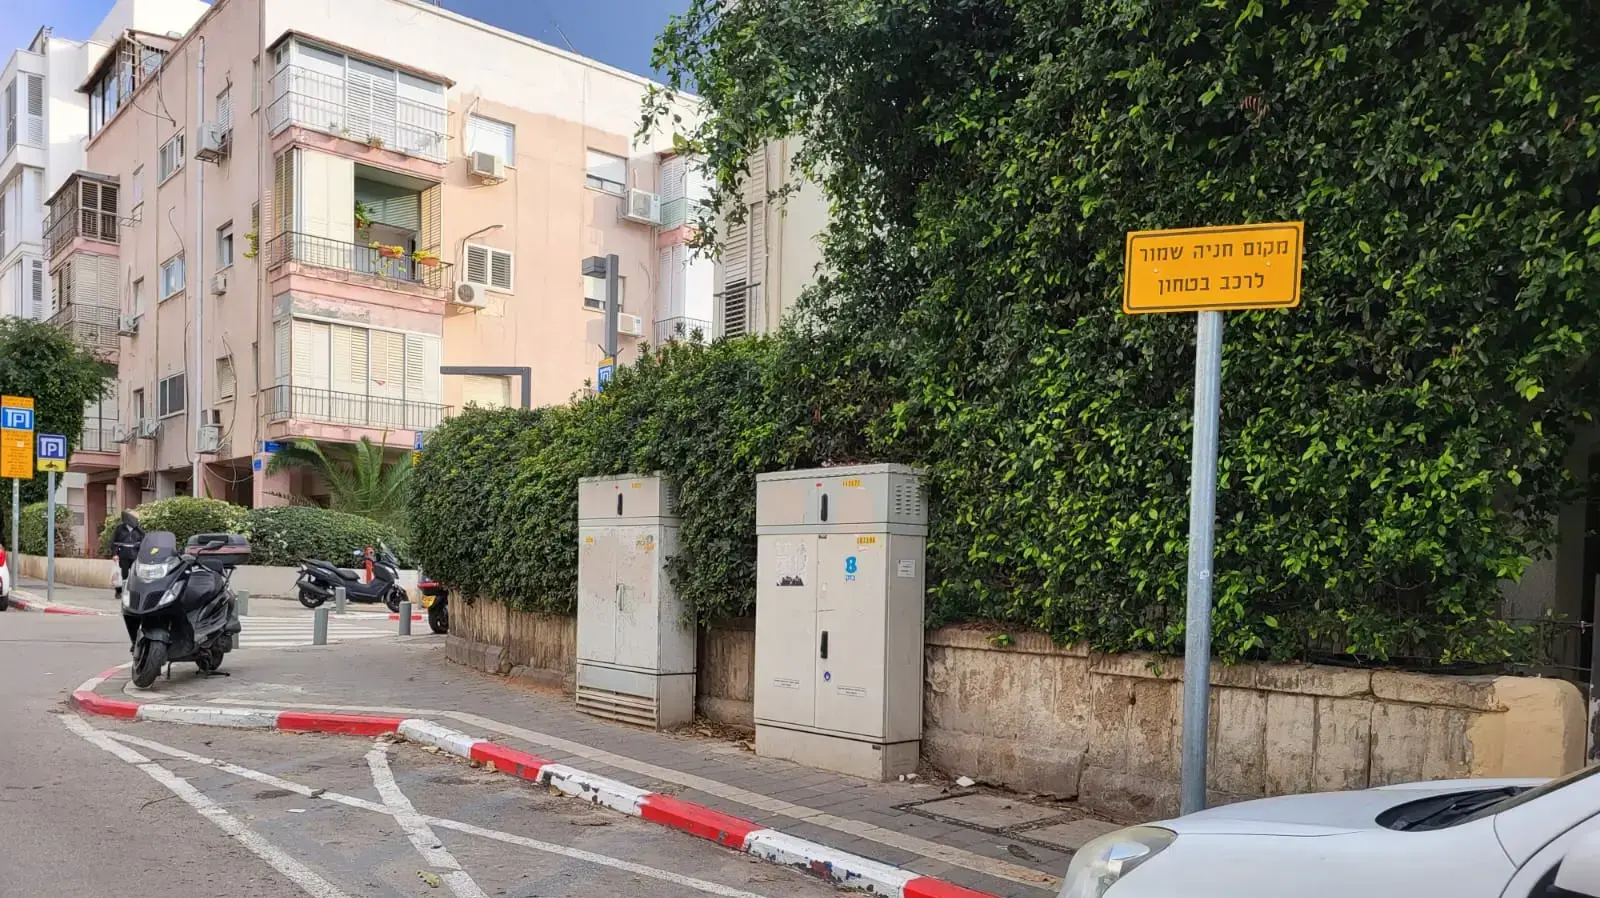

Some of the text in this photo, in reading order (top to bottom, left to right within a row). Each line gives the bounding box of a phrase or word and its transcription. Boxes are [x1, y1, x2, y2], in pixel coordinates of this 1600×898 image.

[1139, 240, 1289, 262] מקום חניה שמור
[1158, 272, 1265, 295] לרכב בטחון
